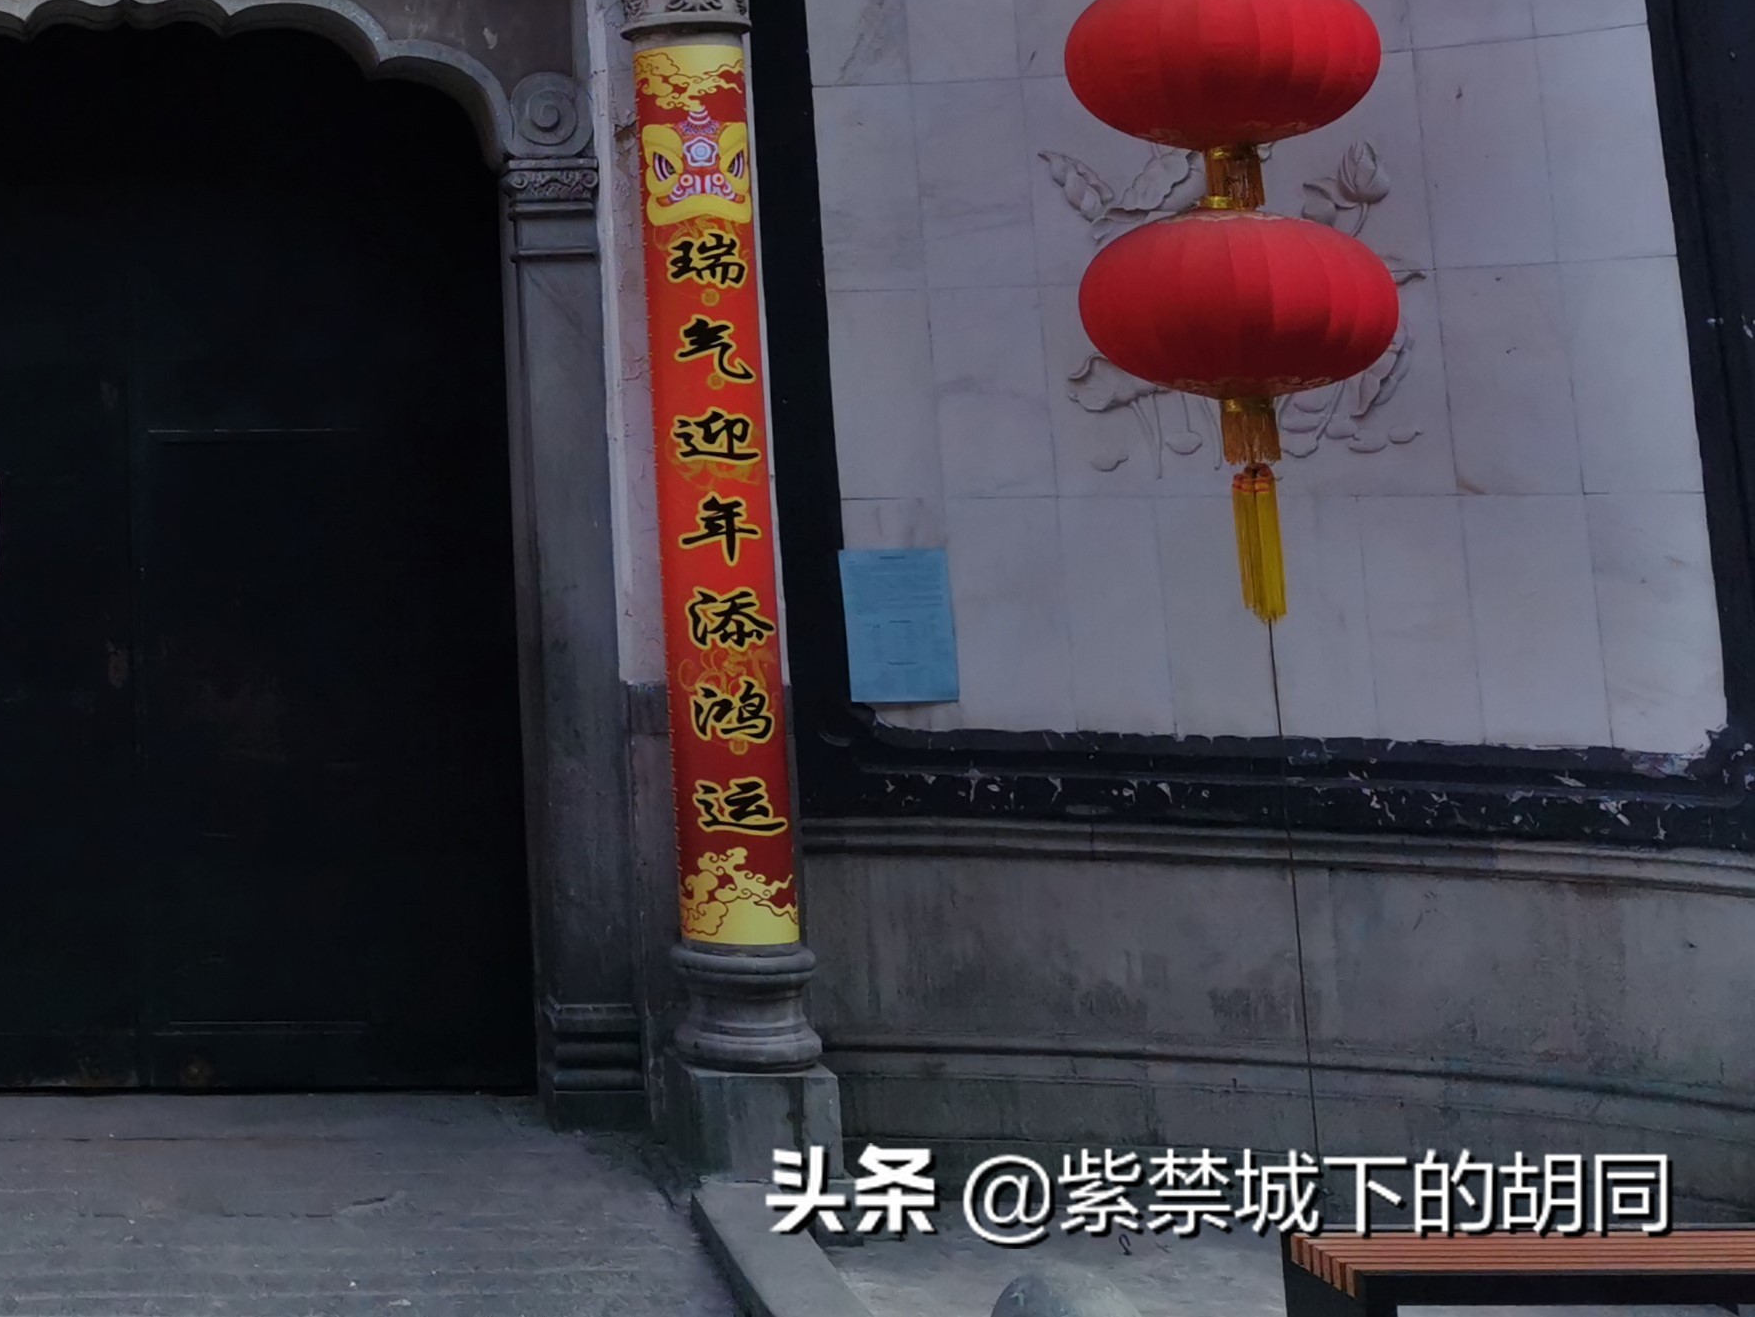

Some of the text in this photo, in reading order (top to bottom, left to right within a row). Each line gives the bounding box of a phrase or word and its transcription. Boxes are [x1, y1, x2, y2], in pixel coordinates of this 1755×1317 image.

[667, 233, 787, 834] 瑞气迎年添鸿运
